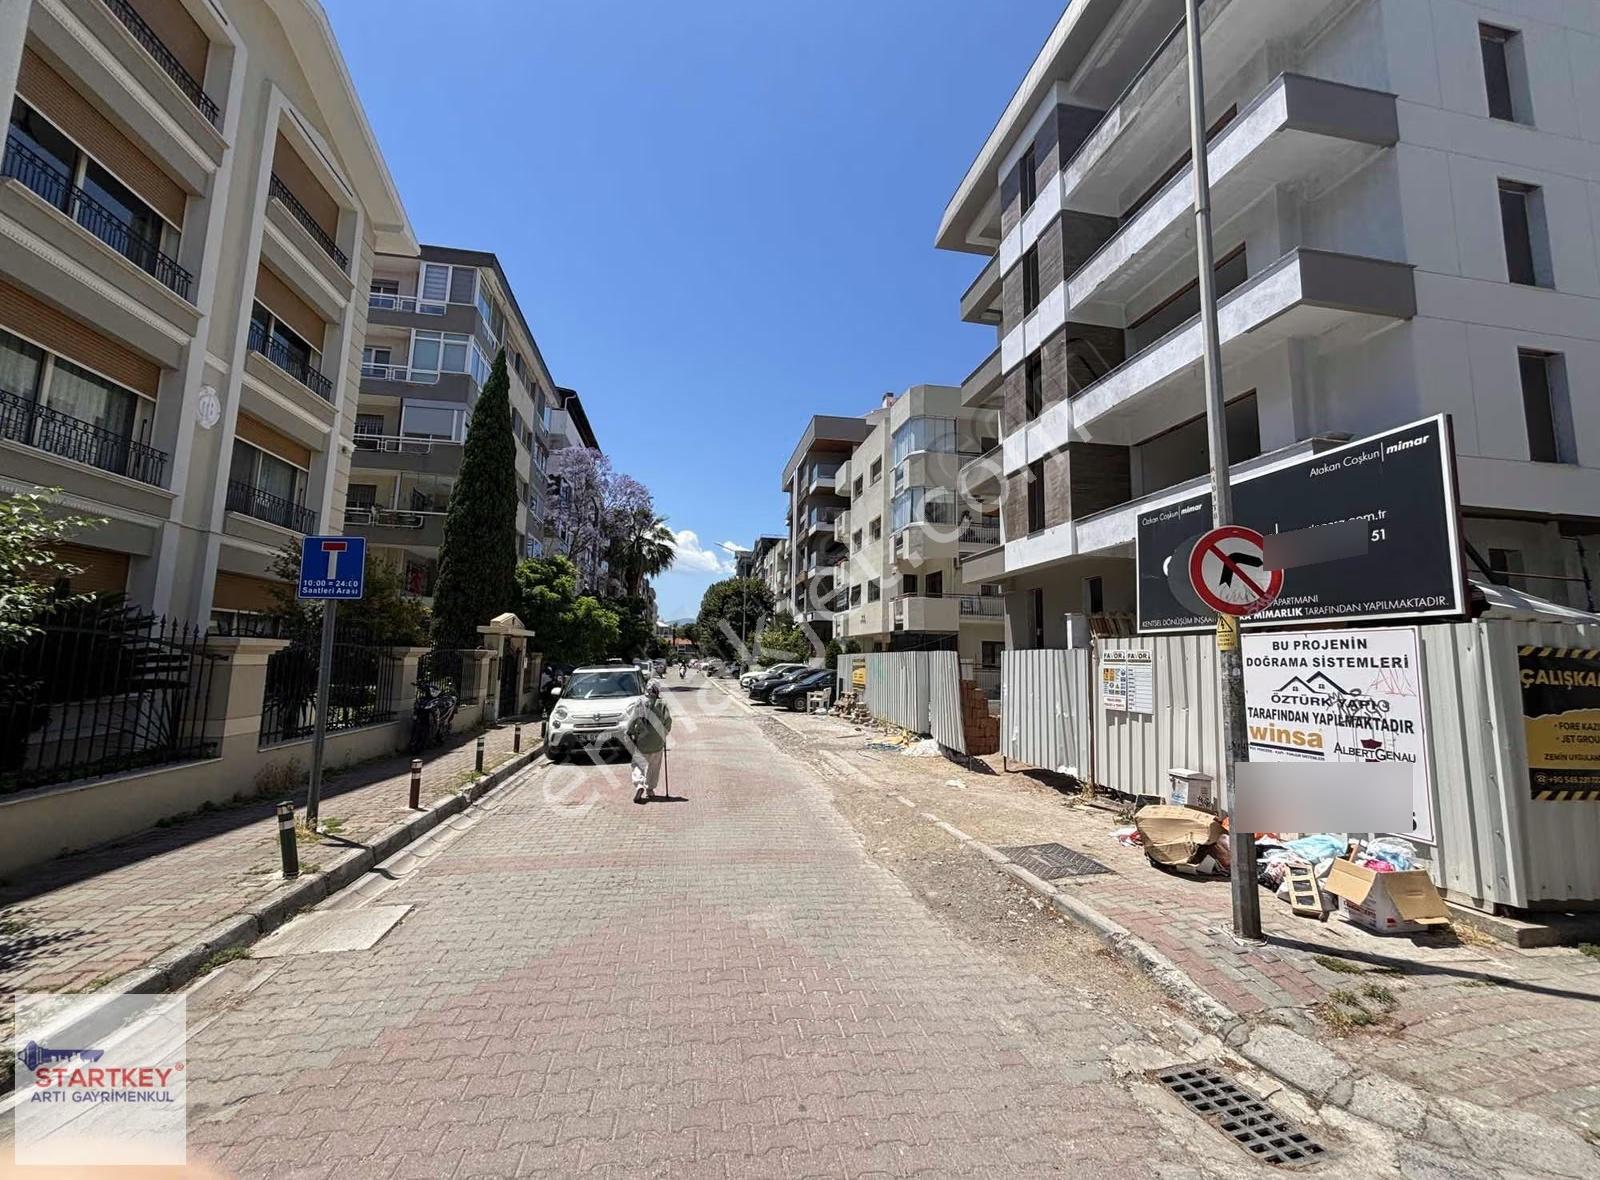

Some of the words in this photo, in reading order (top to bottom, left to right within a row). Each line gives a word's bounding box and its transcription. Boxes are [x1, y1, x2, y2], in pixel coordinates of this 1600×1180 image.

[1309, 461, 1341, 477] Atakan
[1343, 449, 1380, 468] Coşkun
[1386, 434, 1430, 455] mimar
[1180, 504, 1203, 516] mimar
[1371, 528, 1386, 542] 51
[302, 586, 335, 595] Saatleri
[1305, 602, 1361, 616] TARAFINDAN
[1363, 595, 1449, 611] YAPILMAKTADIR.
[1272, 641, 1289, 651] BU
[1294, 636, 1368, 651] PROJENİN
[1246, 655, 1308, 667] DOĞRAMA
[1312, 654, 1409, 669] SİSTEMLERİ
[1271, 693, 1331, 707] ÖZTÜRK
[1248, 706, 1309, 724] TARAFINDAN
[1249, 722, 1325, 749] winsa
